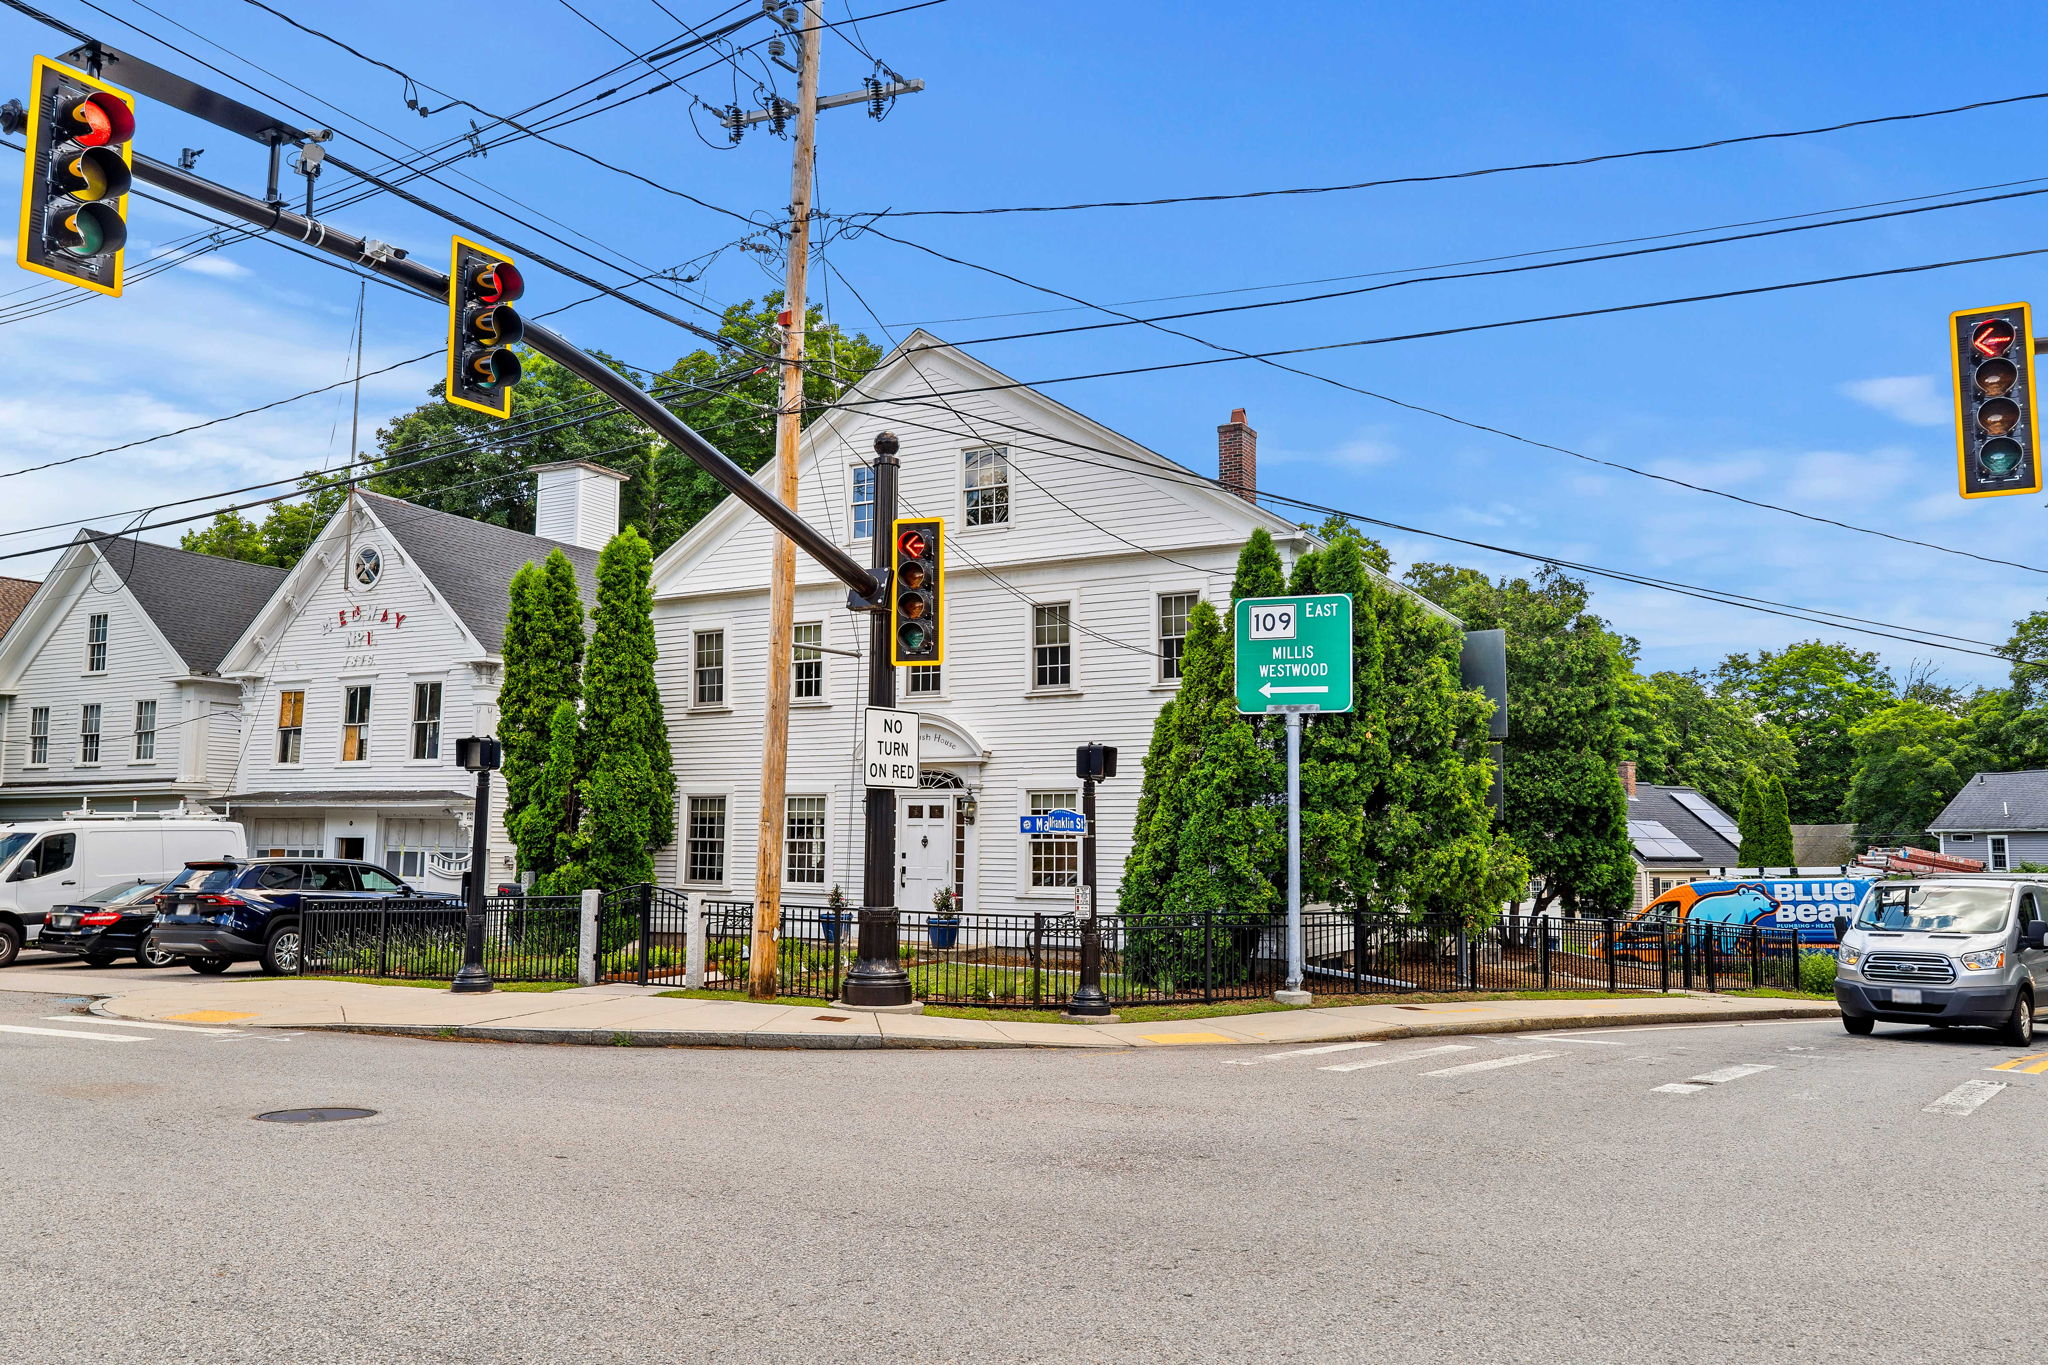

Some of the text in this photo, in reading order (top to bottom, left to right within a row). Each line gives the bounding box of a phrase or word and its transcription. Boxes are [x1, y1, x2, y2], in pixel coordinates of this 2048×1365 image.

[1254, 602, 1338, 632] 109 EAST
[1272, 645, 1314, 660] MILLIS
[1259, 662, 1328, 678] WESTWOOD
[883, 718, 903, 734] NO
[877, 740, 909, 757] TURN
[933, 732, 957, 750] House
[869, 762, 915, 779] ON RED
